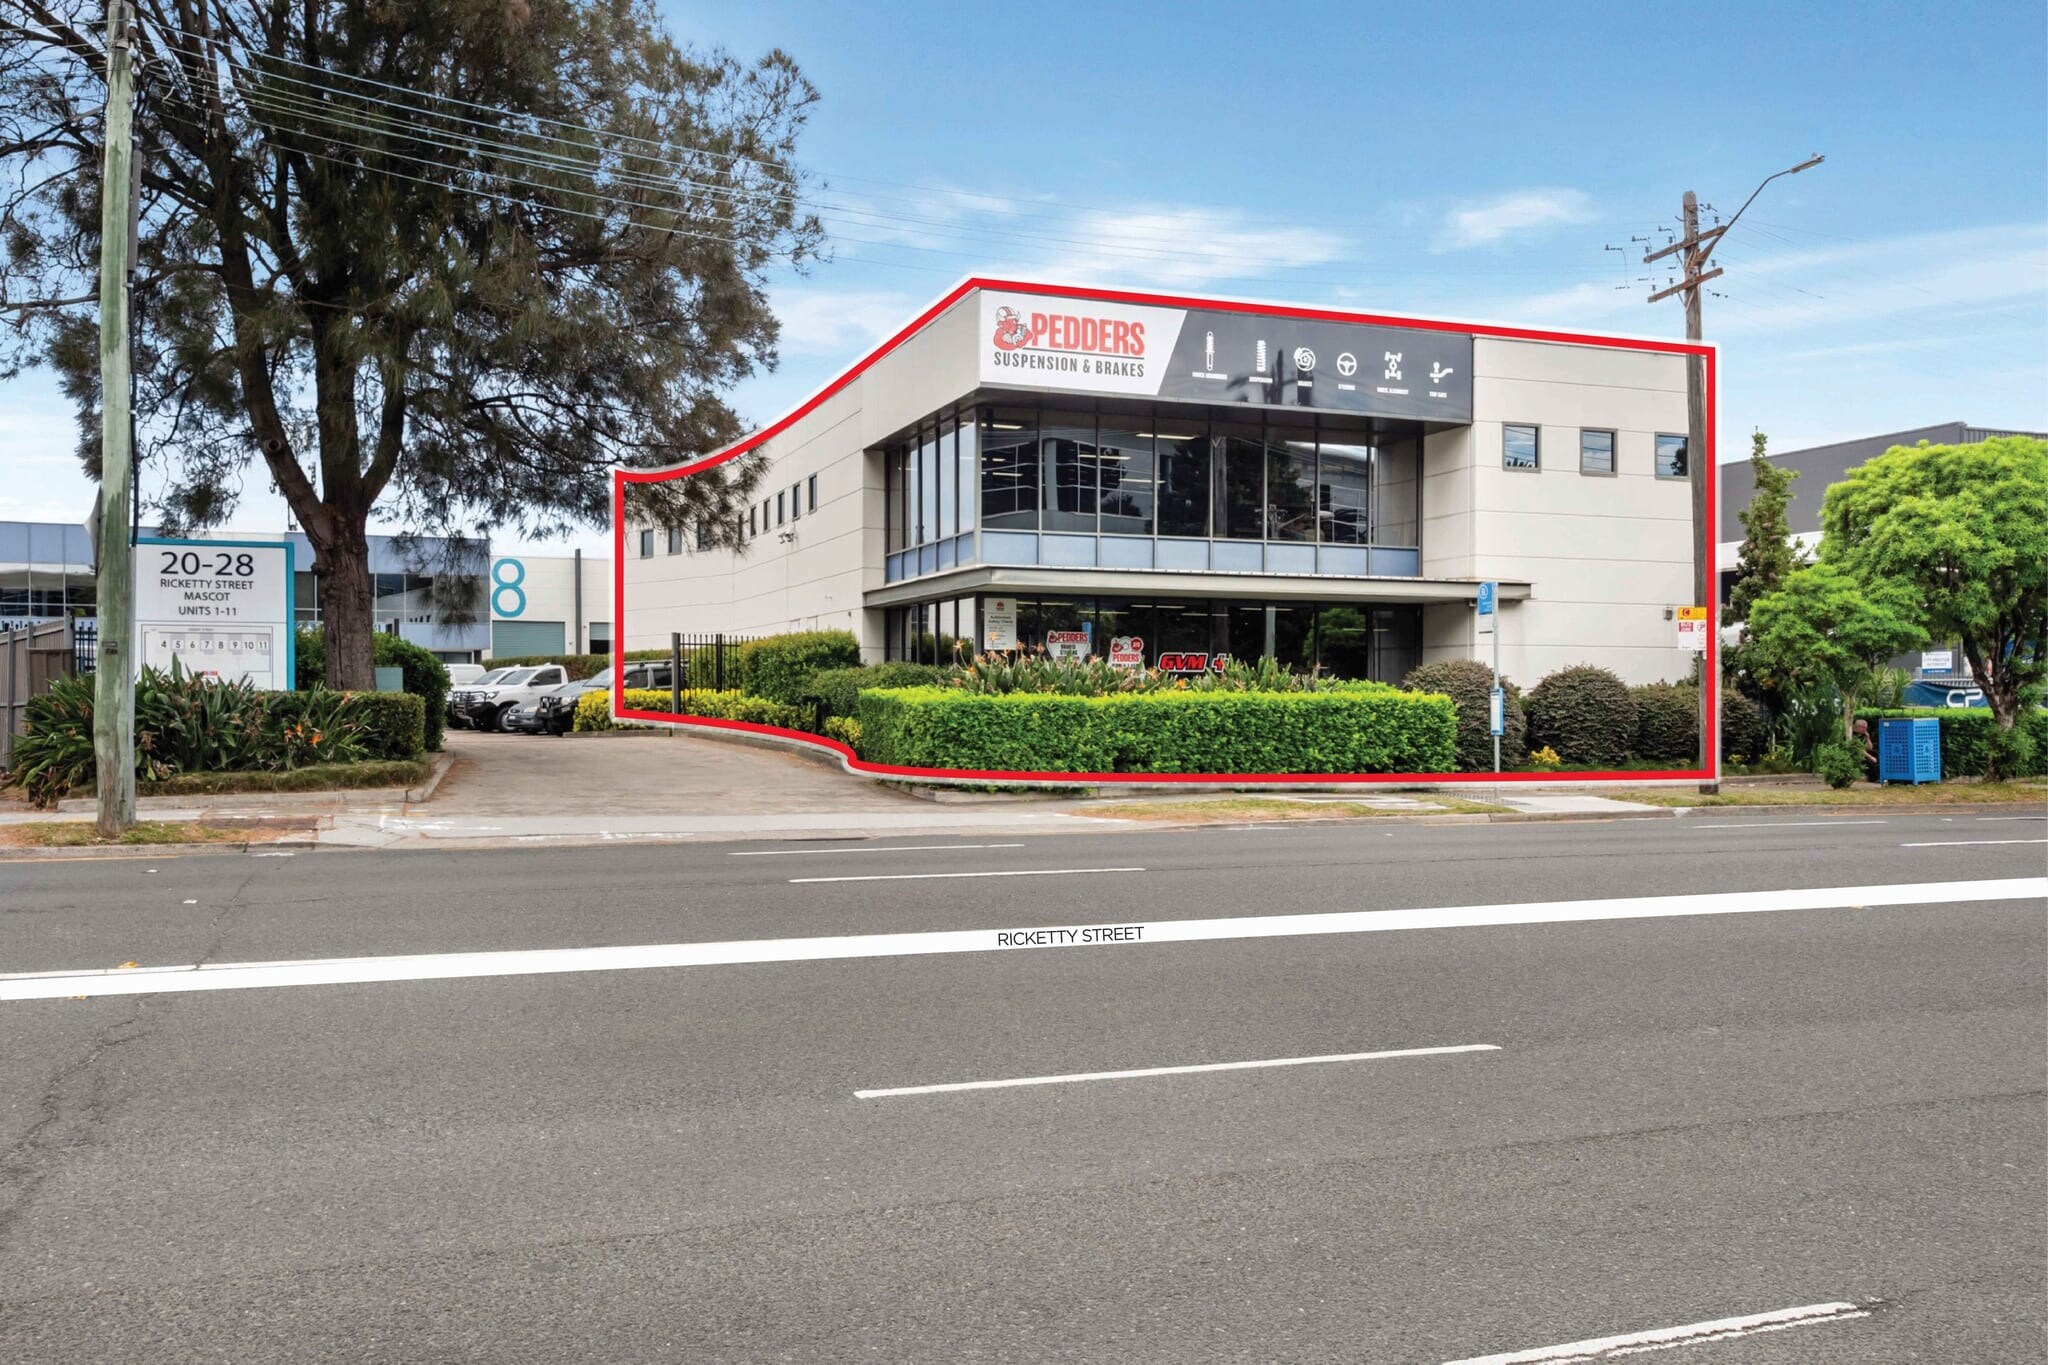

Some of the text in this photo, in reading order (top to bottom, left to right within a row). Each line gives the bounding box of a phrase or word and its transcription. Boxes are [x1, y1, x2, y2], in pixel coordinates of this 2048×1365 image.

[1031, 312, 1145, 356] PEDDERS
[994, 351, 1145, 378] SUSPENSION & BRAKES
[160, 551, 254, 577] 20-28
[160, 578, 255, 590] RICKETTY STREET
[491, 558, 527, 618] 8
[183, 591, 231, 602] MASCOT
[178, 605, 237, 617] UNITS 1-11
[1057, 632, 1089, 644] PEDDERS
[161, 641, 167, 649] 4
[175, 641, 181, 649] 5
[190, 641, 195, 649] 6
[204, 641, 210, 649] 7
[218, 641, 224, 649] 8
[232, 641, 238, 649] 9
[244, 641, 254, 650] 10
[1112, 653, 1140, 663] PEDDERS
[1160, 654, 1207, 671] GVM
